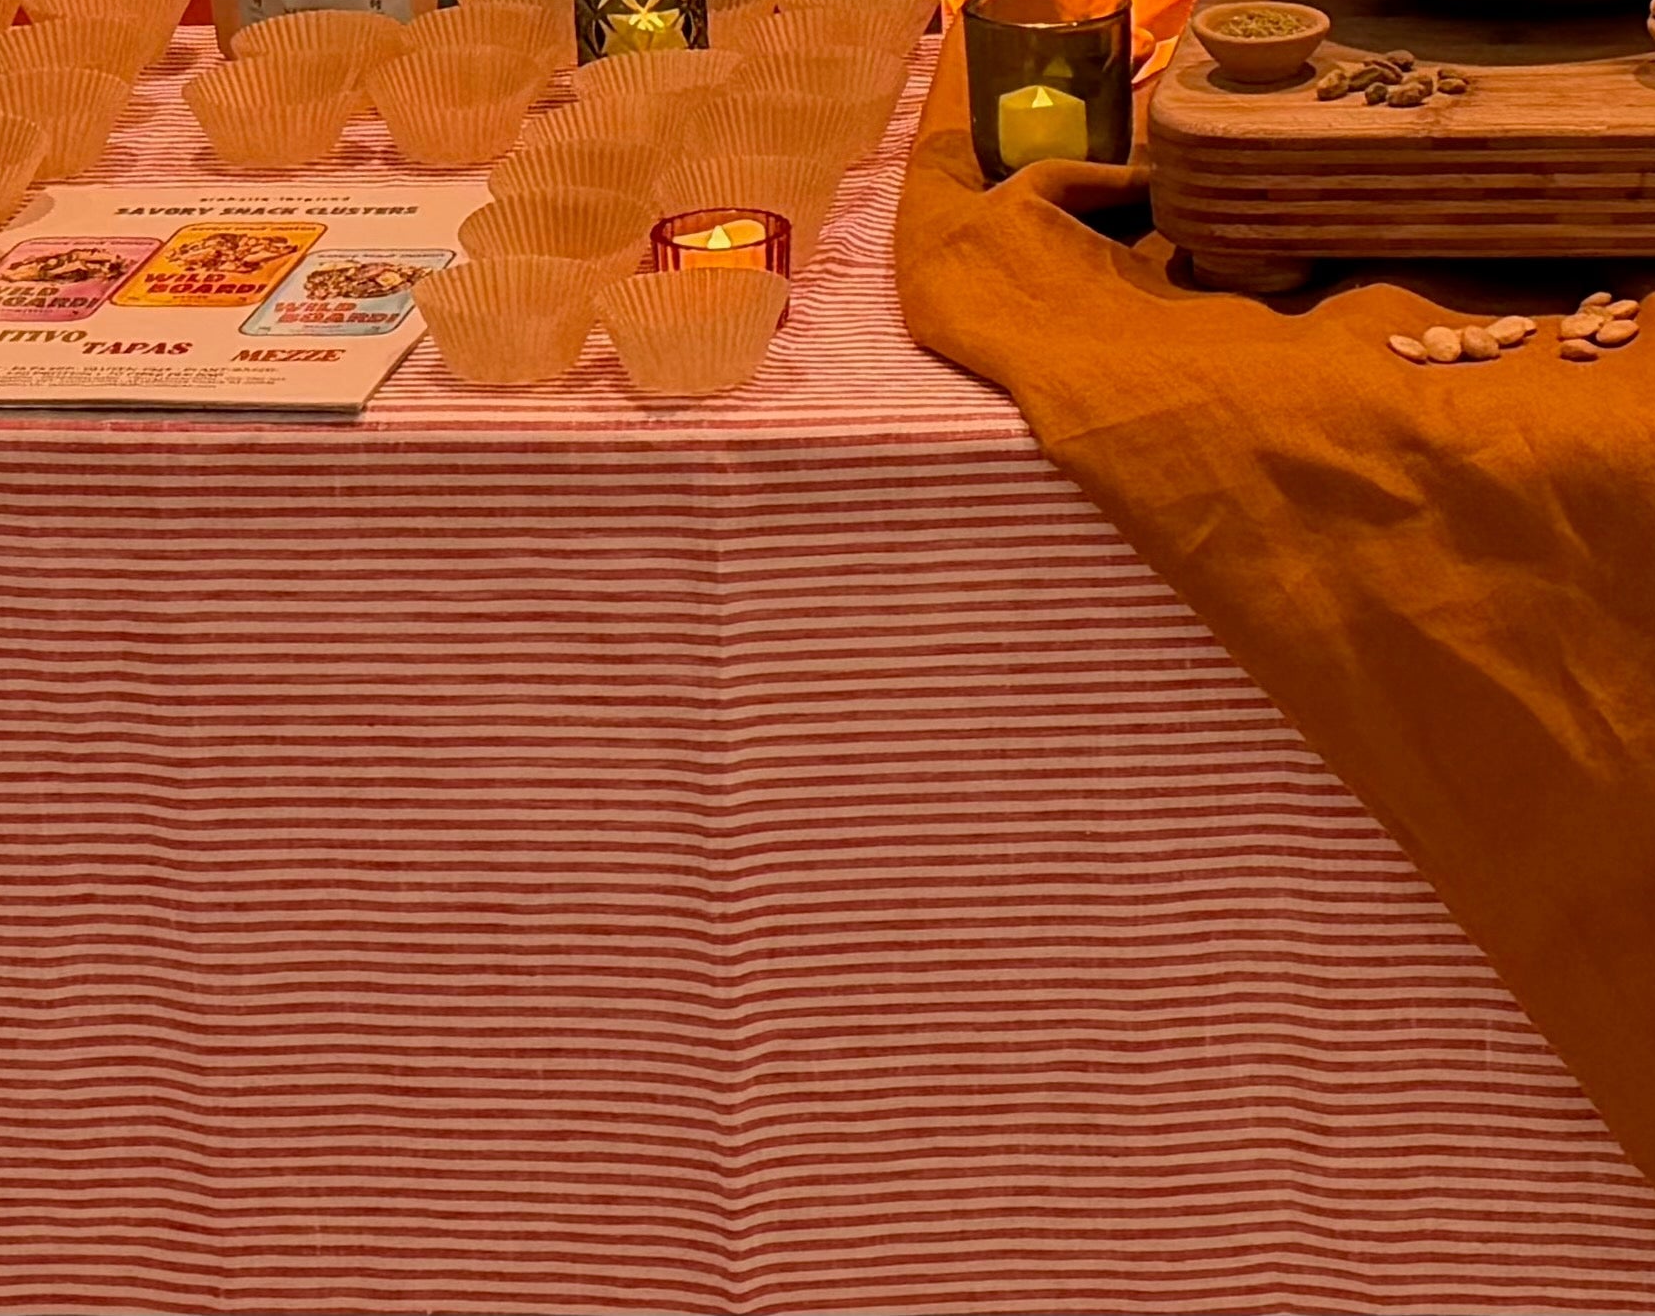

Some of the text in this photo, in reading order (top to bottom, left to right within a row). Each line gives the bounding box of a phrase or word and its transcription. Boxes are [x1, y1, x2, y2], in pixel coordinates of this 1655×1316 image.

[115, 206, 419, 216] SAVORY SNACK CLUSTERS
[145, 272, 226, 283] WILD
[147, 283, 267, 295] BOARD!
[81, 341, 193, 357] TAPAS
[231, 348, 345, 364] MEZZE
